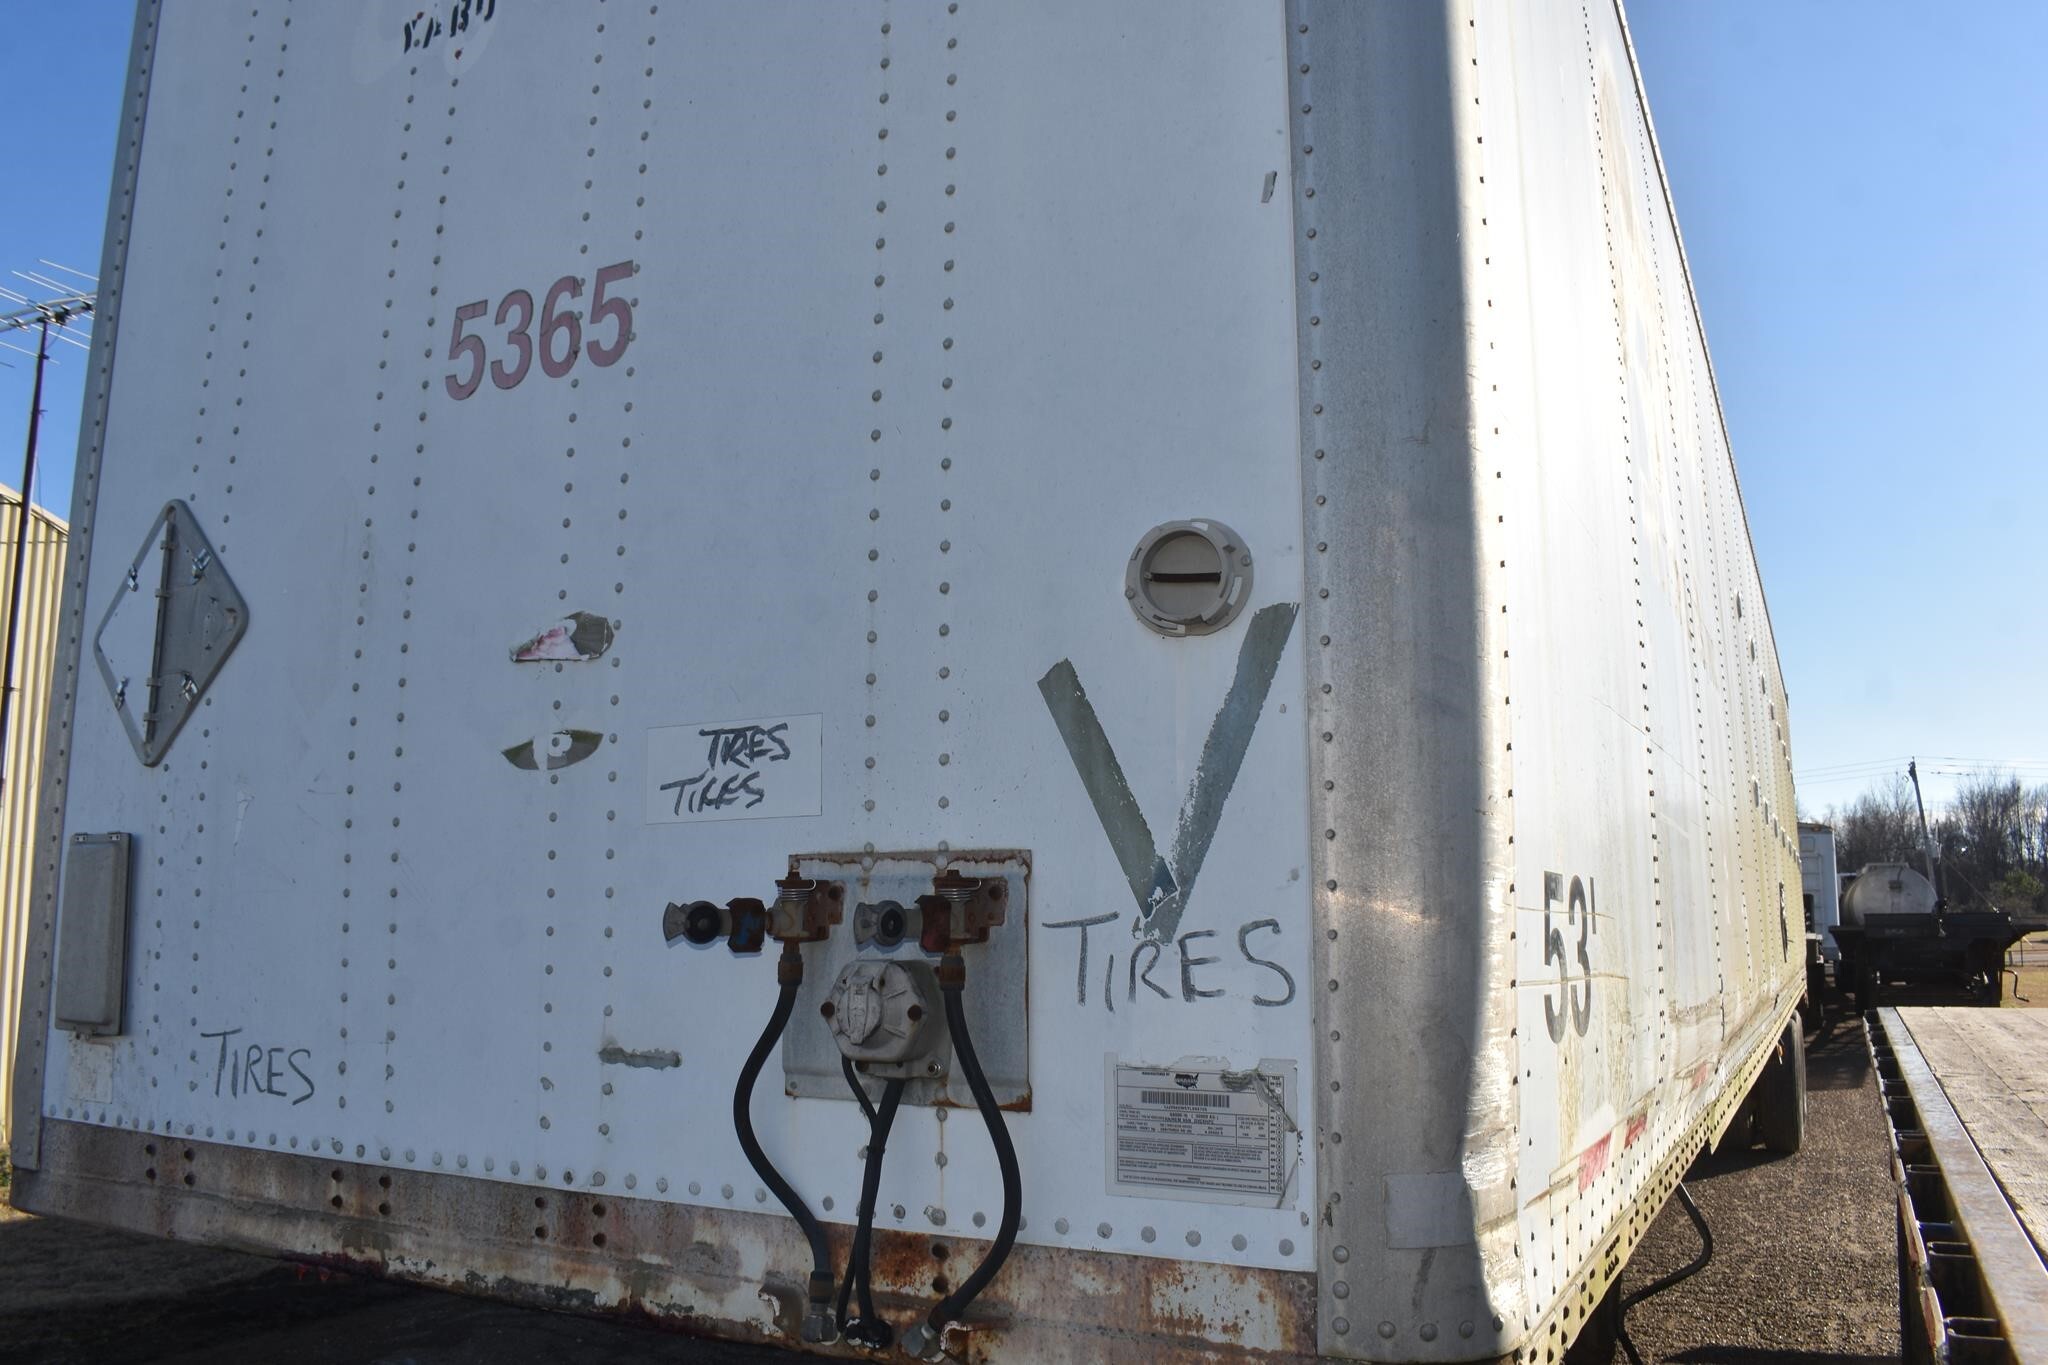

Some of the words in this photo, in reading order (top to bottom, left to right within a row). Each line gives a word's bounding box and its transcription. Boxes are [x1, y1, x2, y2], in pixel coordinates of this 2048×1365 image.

[445, 260, 634, 401] 5365
[698, 722, 791, 771] TIRES
[660, 768, 765, 816] TIRES
[1042, 912, 1296, 1013] TIRES
[201, 1028, 315, 1105] TIRES
